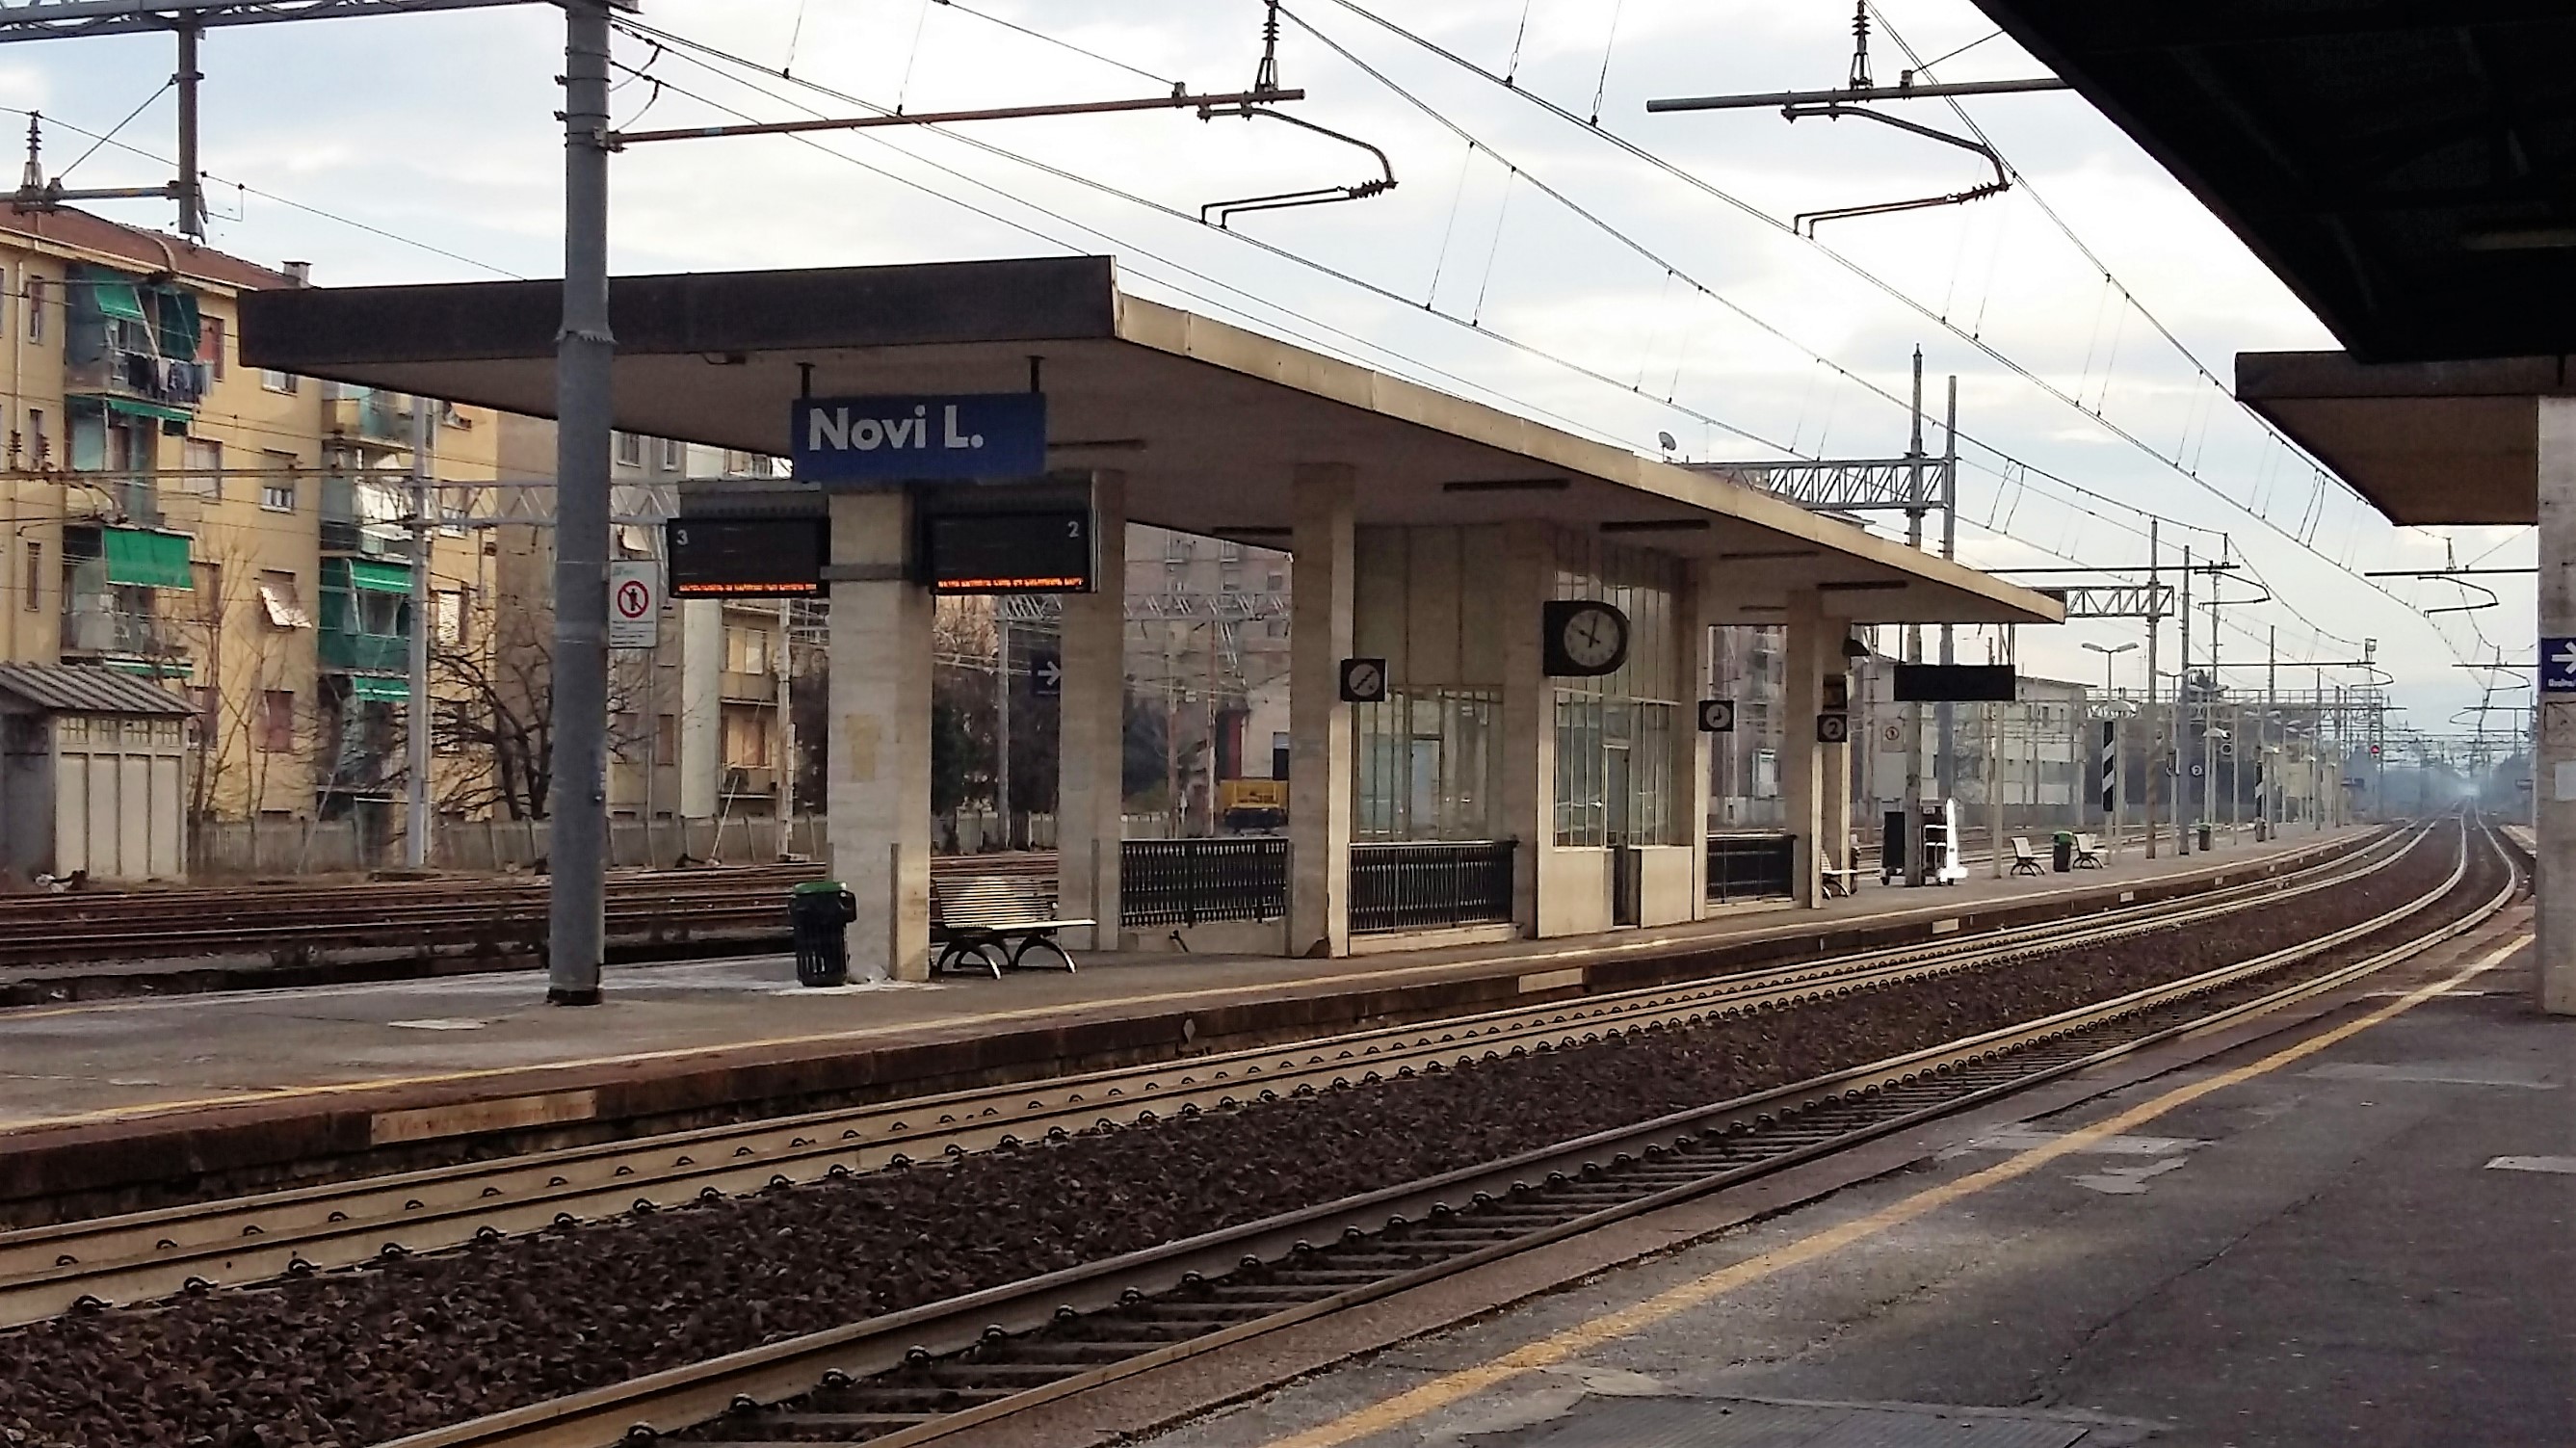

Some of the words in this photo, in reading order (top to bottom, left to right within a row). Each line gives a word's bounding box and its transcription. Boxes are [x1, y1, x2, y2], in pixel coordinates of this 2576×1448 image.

[809, 405, 926, 451] Novi
[944, 405, 984, 449] L.
[677, 529, 688, 545] 3
[1068, 521, 1079, 538] 2
